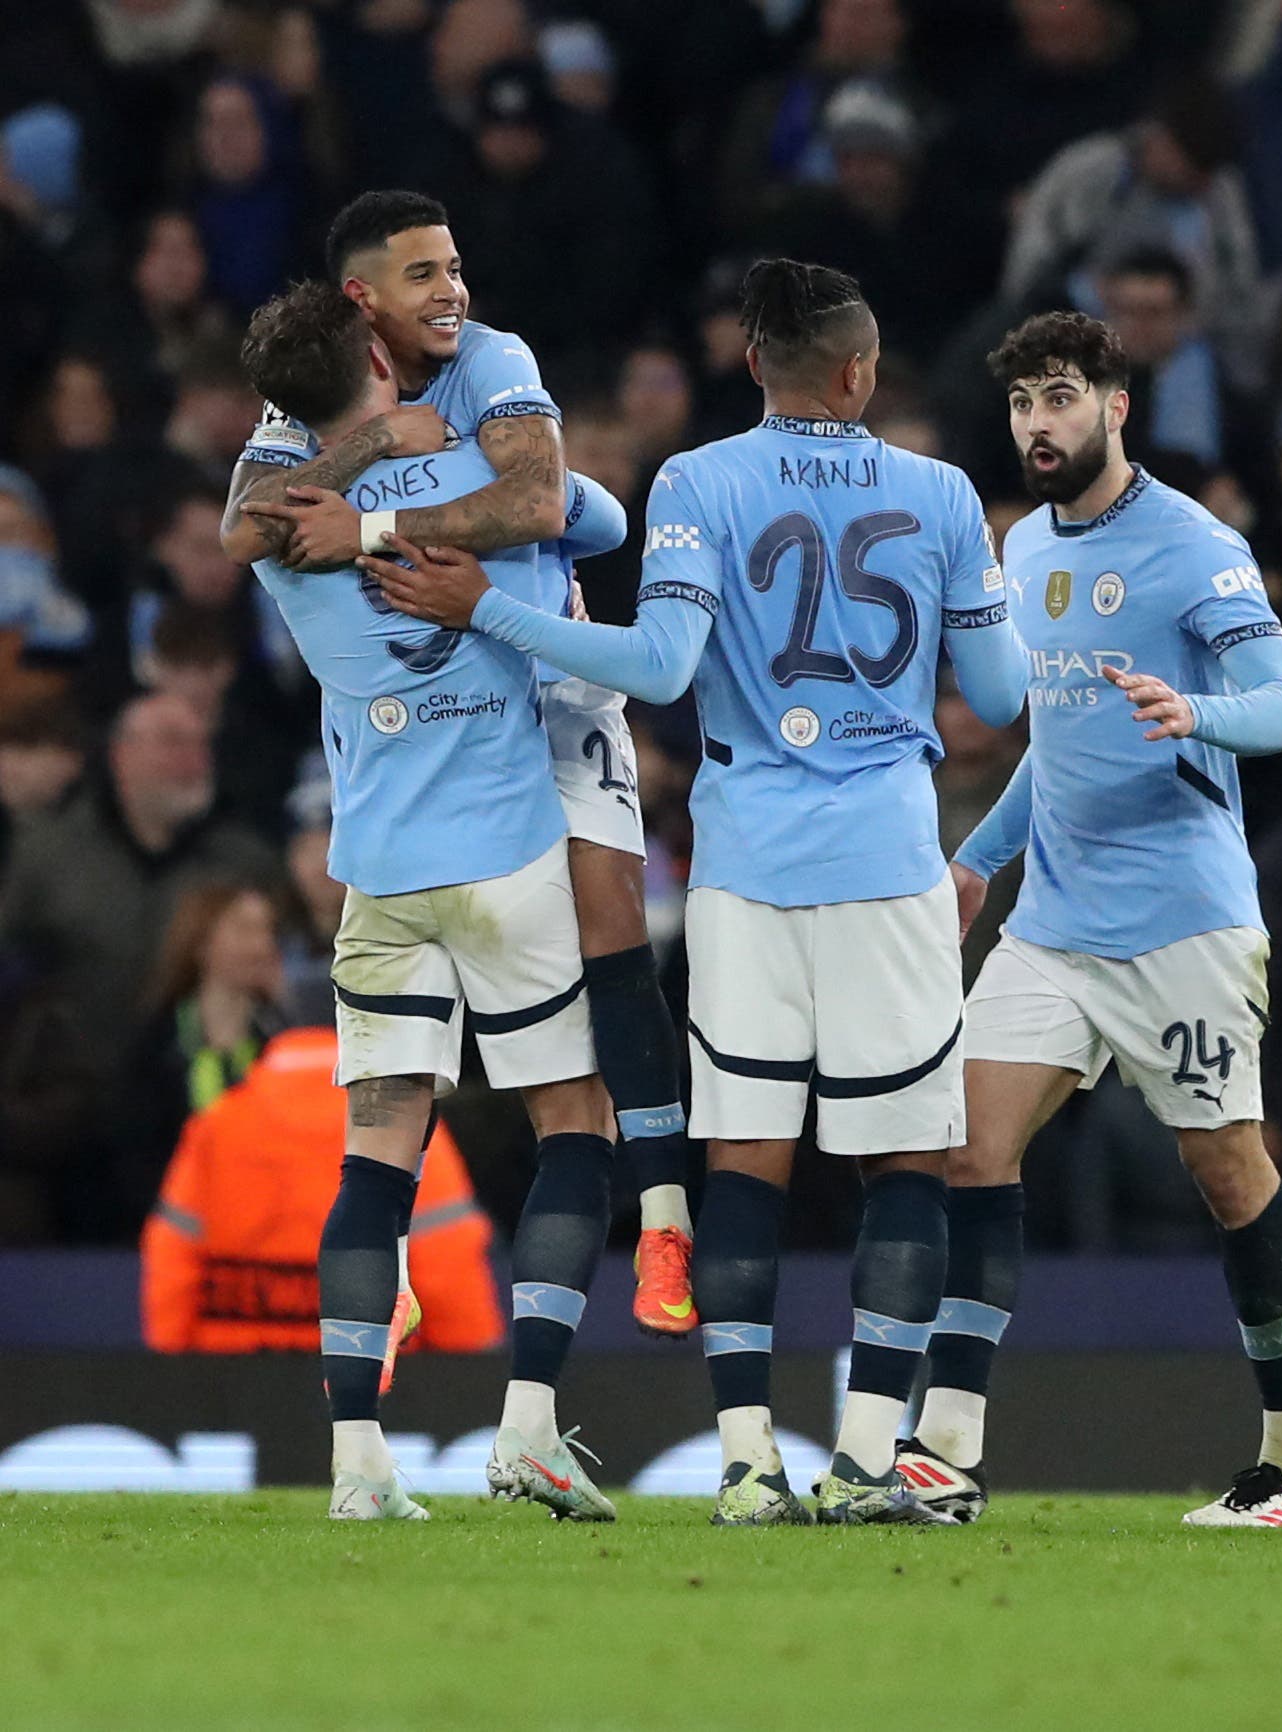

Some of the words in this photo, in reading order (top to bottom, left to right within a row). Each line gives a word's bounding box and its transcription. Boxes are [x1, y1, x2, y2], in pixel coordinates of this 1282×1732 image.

[341, 459, 439, 513] ONES
[779, 456, 878, 489] AKANJI
[746, 509, 922, 689] 25
[1031, 649, 1134, 679] IHAD
[417, 691, 507, 724] Community
[429, 692, 459, 707] City
[843, 710, 875, 725] City
[1161, 1018, 1236, 1086] 24
